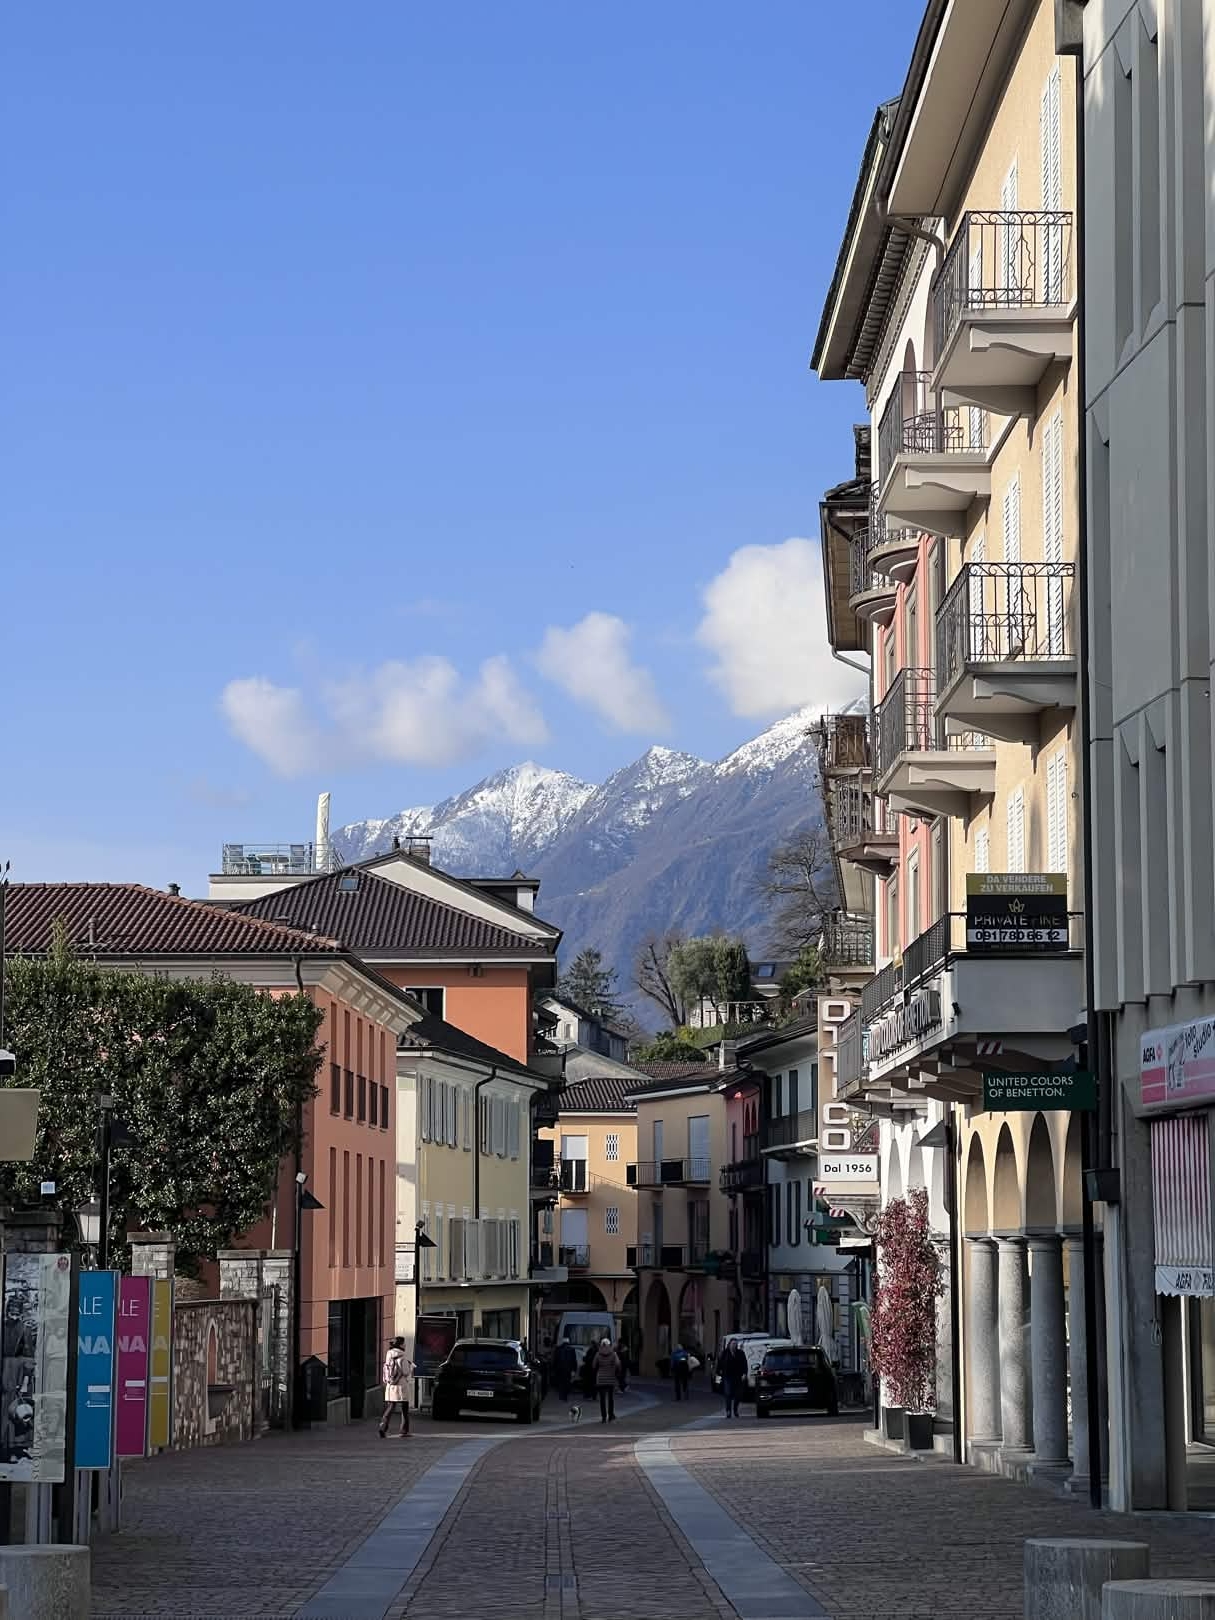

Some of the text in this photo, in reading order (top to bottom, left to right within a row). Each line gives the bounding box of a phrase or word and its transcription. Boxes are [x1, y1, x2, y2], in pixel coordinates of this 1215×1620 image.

[986, 875, 1047, 883] DA VENDERE
[981, 884, 1053, 892] ZU VERKAUFEN
[974, 915, 1028, 926] PRIVATE
[1142, 1047, 1156, 1064] AGFA
[988, 1076, 1074, 1087] UNITED COLORS
[989, 1088, 1003, 1098] OF
[824, 1163, 872, 1173] Dal 1956
[1175, 1271, 1192, 1290] AGFA
